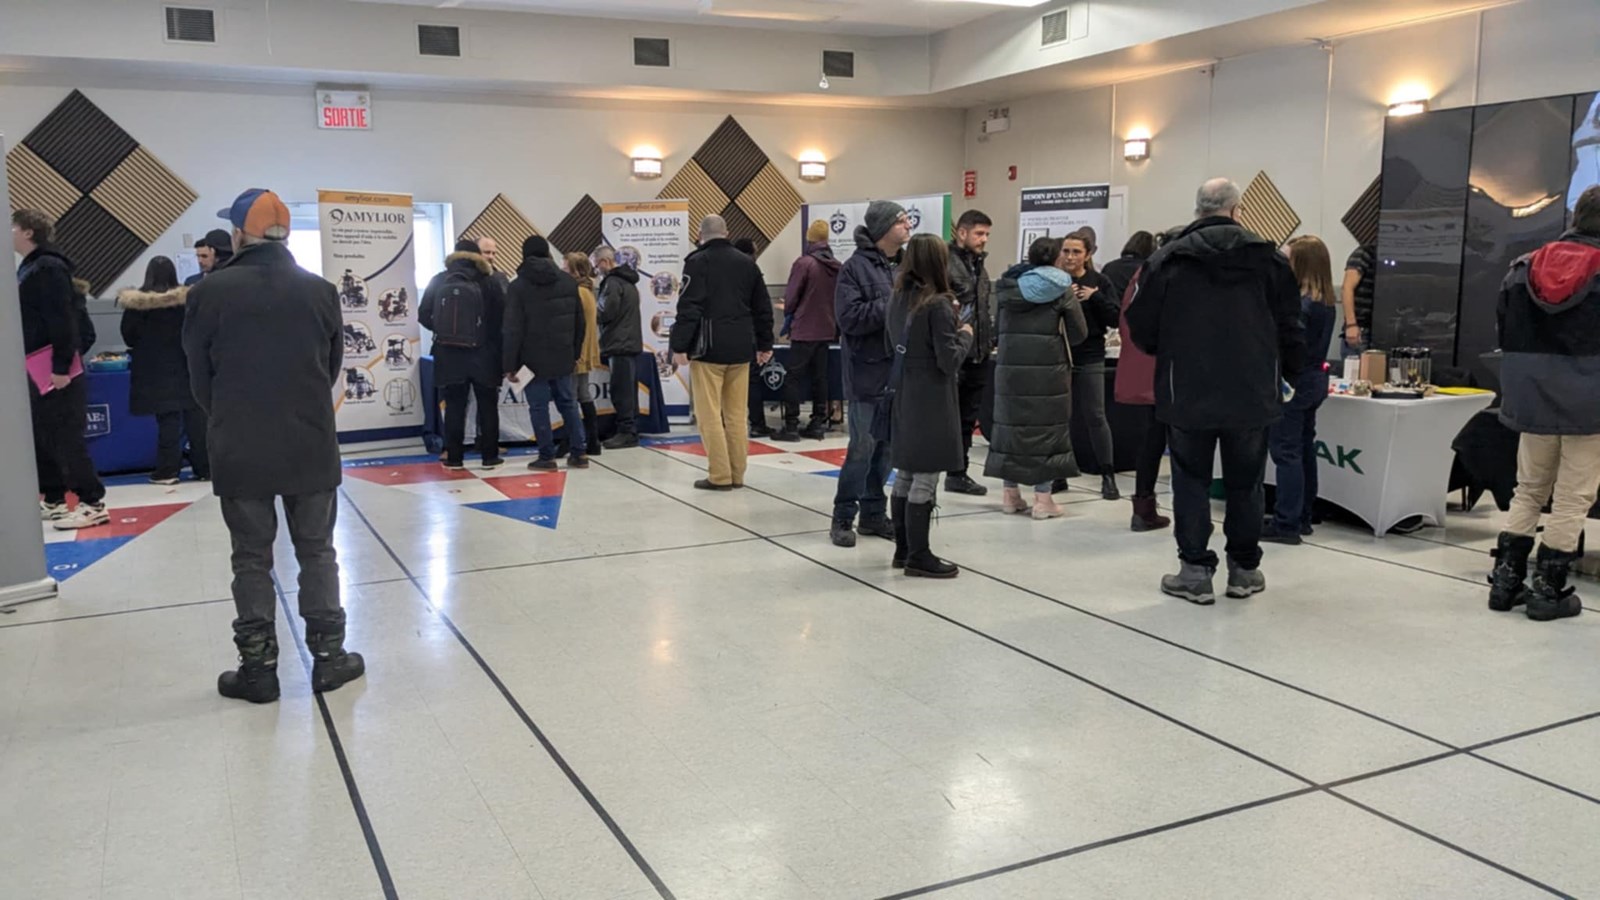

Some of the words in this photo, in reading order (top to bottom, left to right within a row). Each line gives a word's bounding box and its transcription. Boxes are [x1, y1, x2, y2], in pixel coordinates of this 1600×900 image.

[323, 107, 367, 127] SORTIE
[344, 195, 389, 203] amylior.com
[1023, 193, 1045, 201] BESOIN
[1046, 192, 1062, 200] D'UN
[1062, 190, 1103, 198] GAGNE-PAIN
[625, 203, 666, 211] amylior.com
[345, 211, 406, 224] AMYLIOR
[624, 217, 680, 228] AMYLIOR
[53, 563, 78, 571] 10
